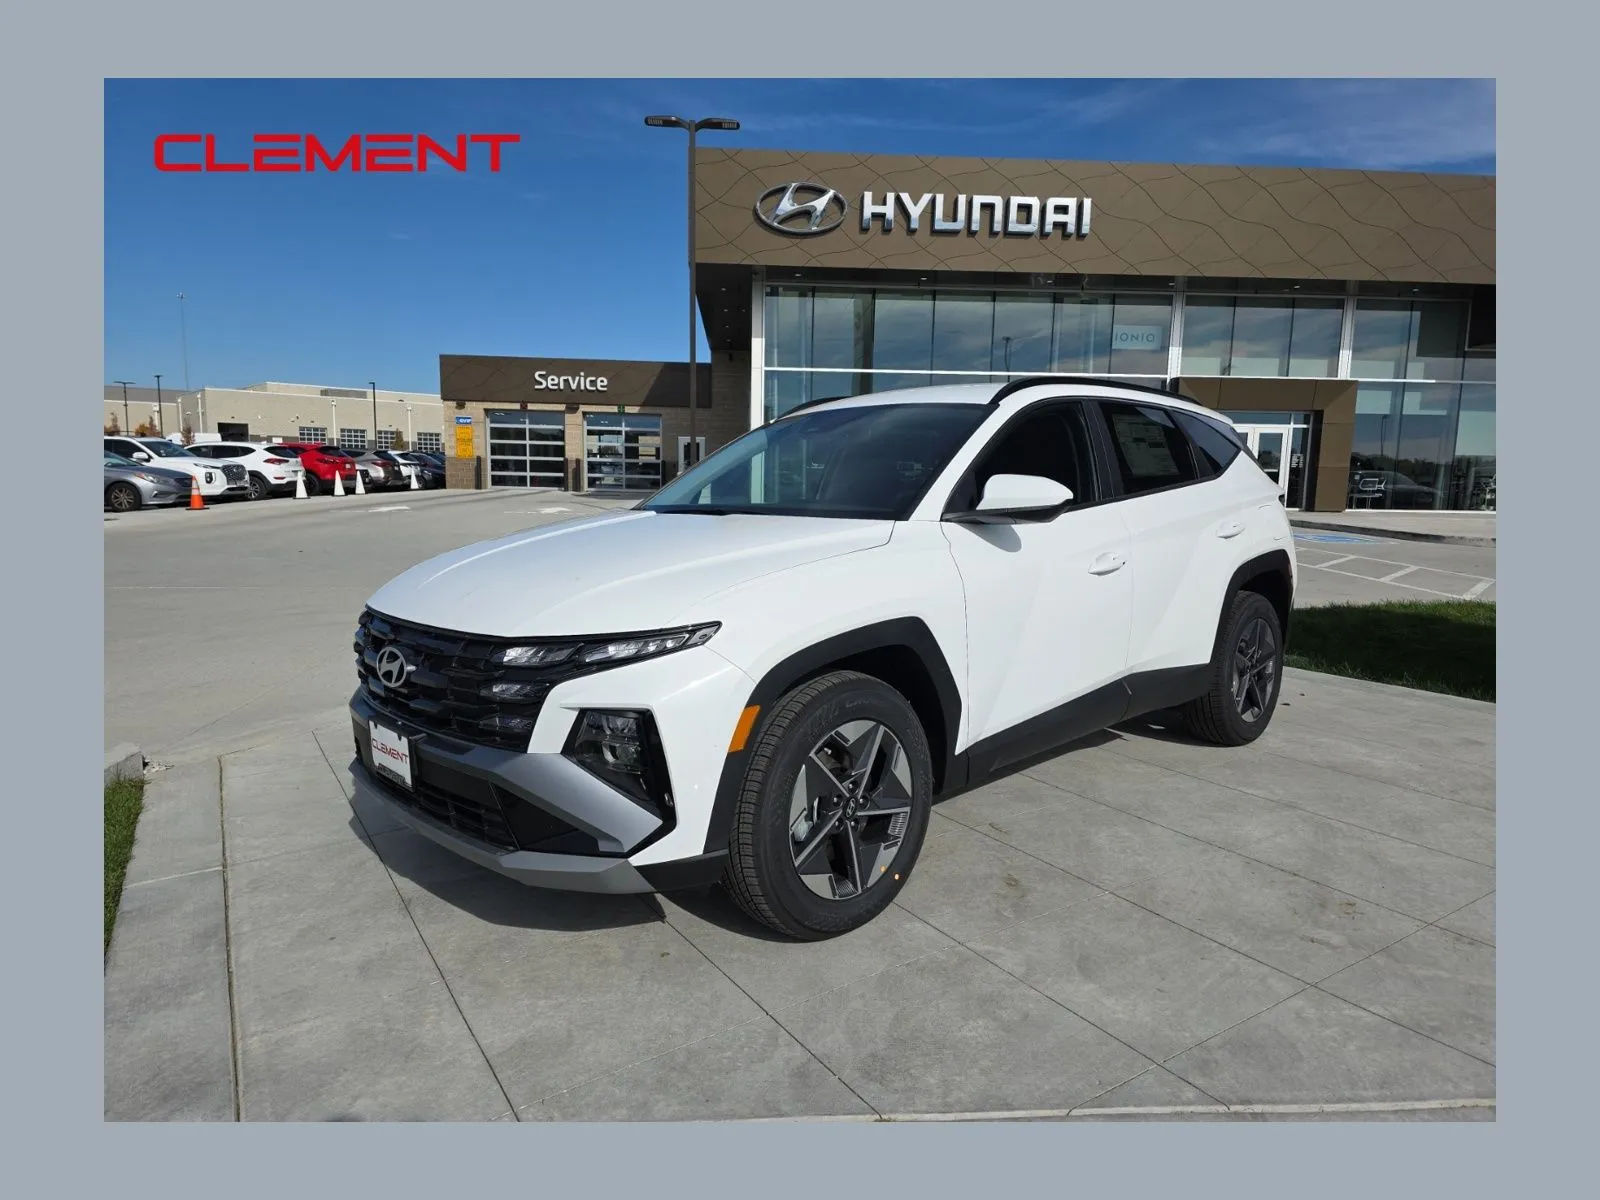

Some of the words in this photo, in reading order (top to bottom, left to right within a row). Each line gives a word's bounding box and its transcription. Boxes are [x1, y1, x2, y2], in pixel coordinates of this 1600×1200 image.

[861, 191, 1092, 236] HYUNDAI
[534, 371, 608, 391] Service
[372, 737, 408, 764] CLEMENT
